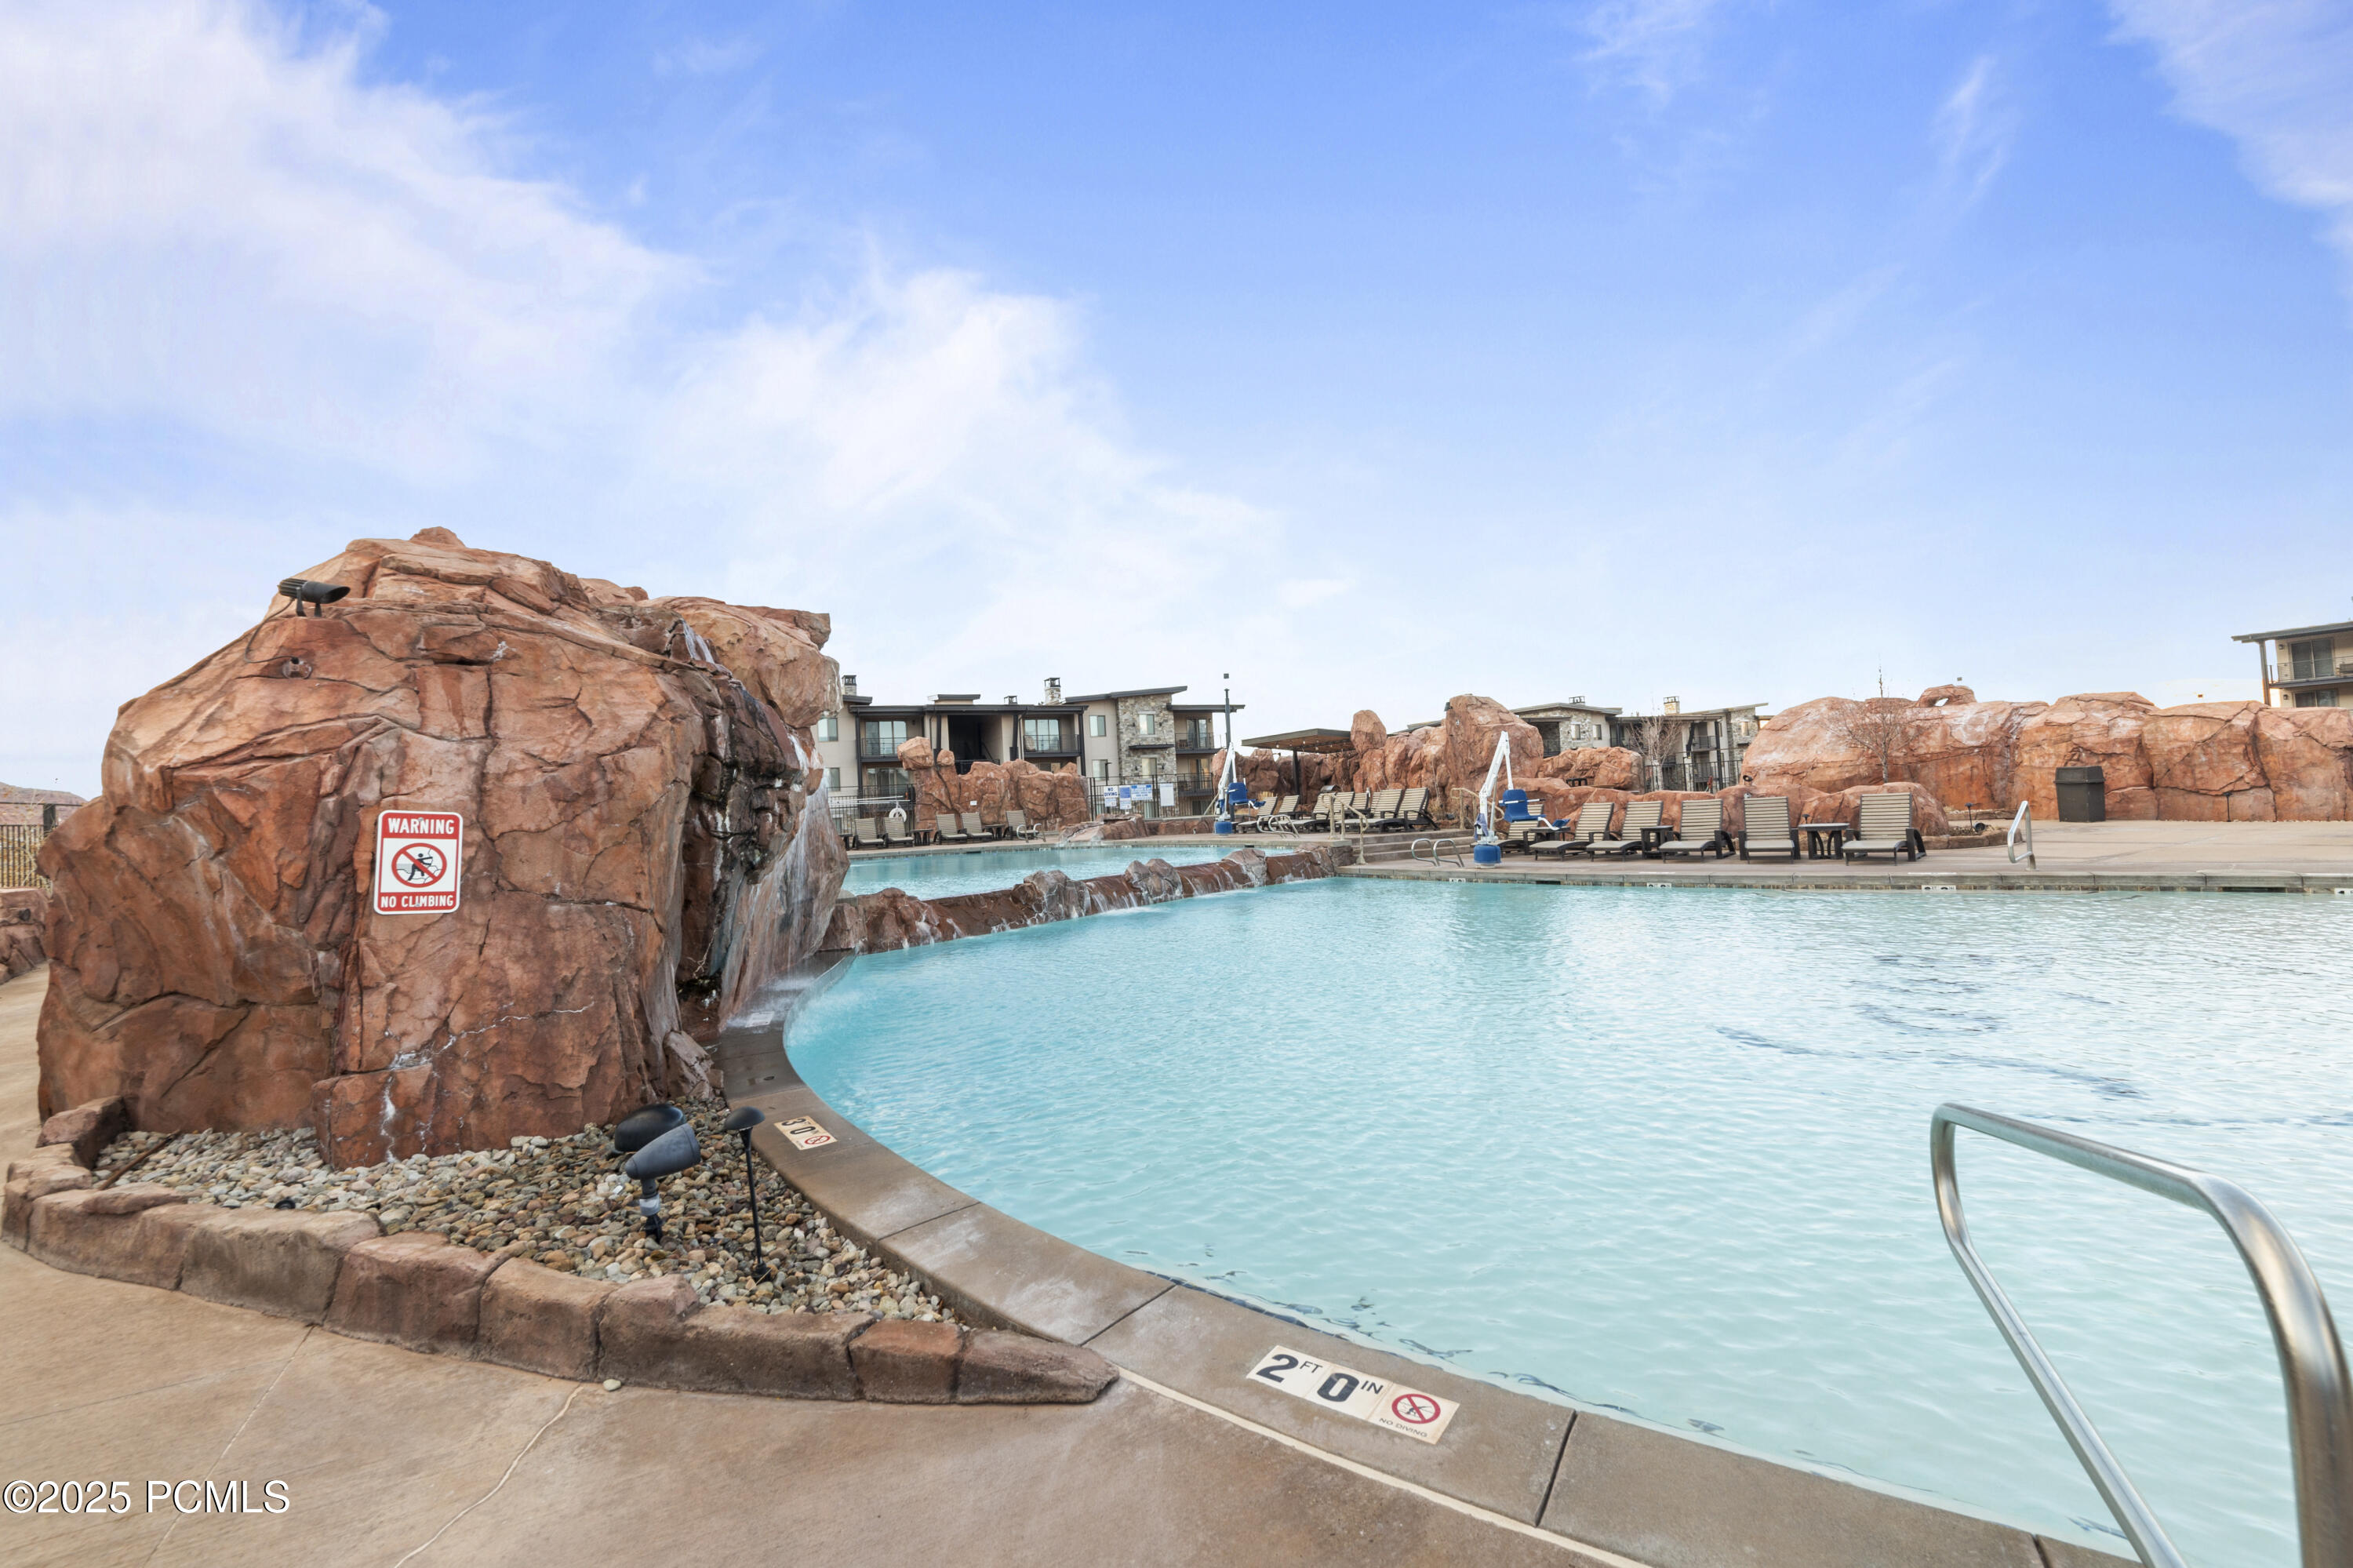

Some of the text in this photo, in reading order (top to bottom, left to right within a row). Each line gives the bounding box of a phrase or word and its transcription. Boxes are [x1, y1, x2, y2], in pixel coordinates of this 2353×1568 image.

[387, 817, 455, 835] WARNING
[380, 895, 453, 908] NO CLIMBING
[781, 1118, 806, 1126] 3
[1256, 1354, 1384, 1402] 2 FT 0 IN
[1395, 1423, 1427, 1438] DIVING
